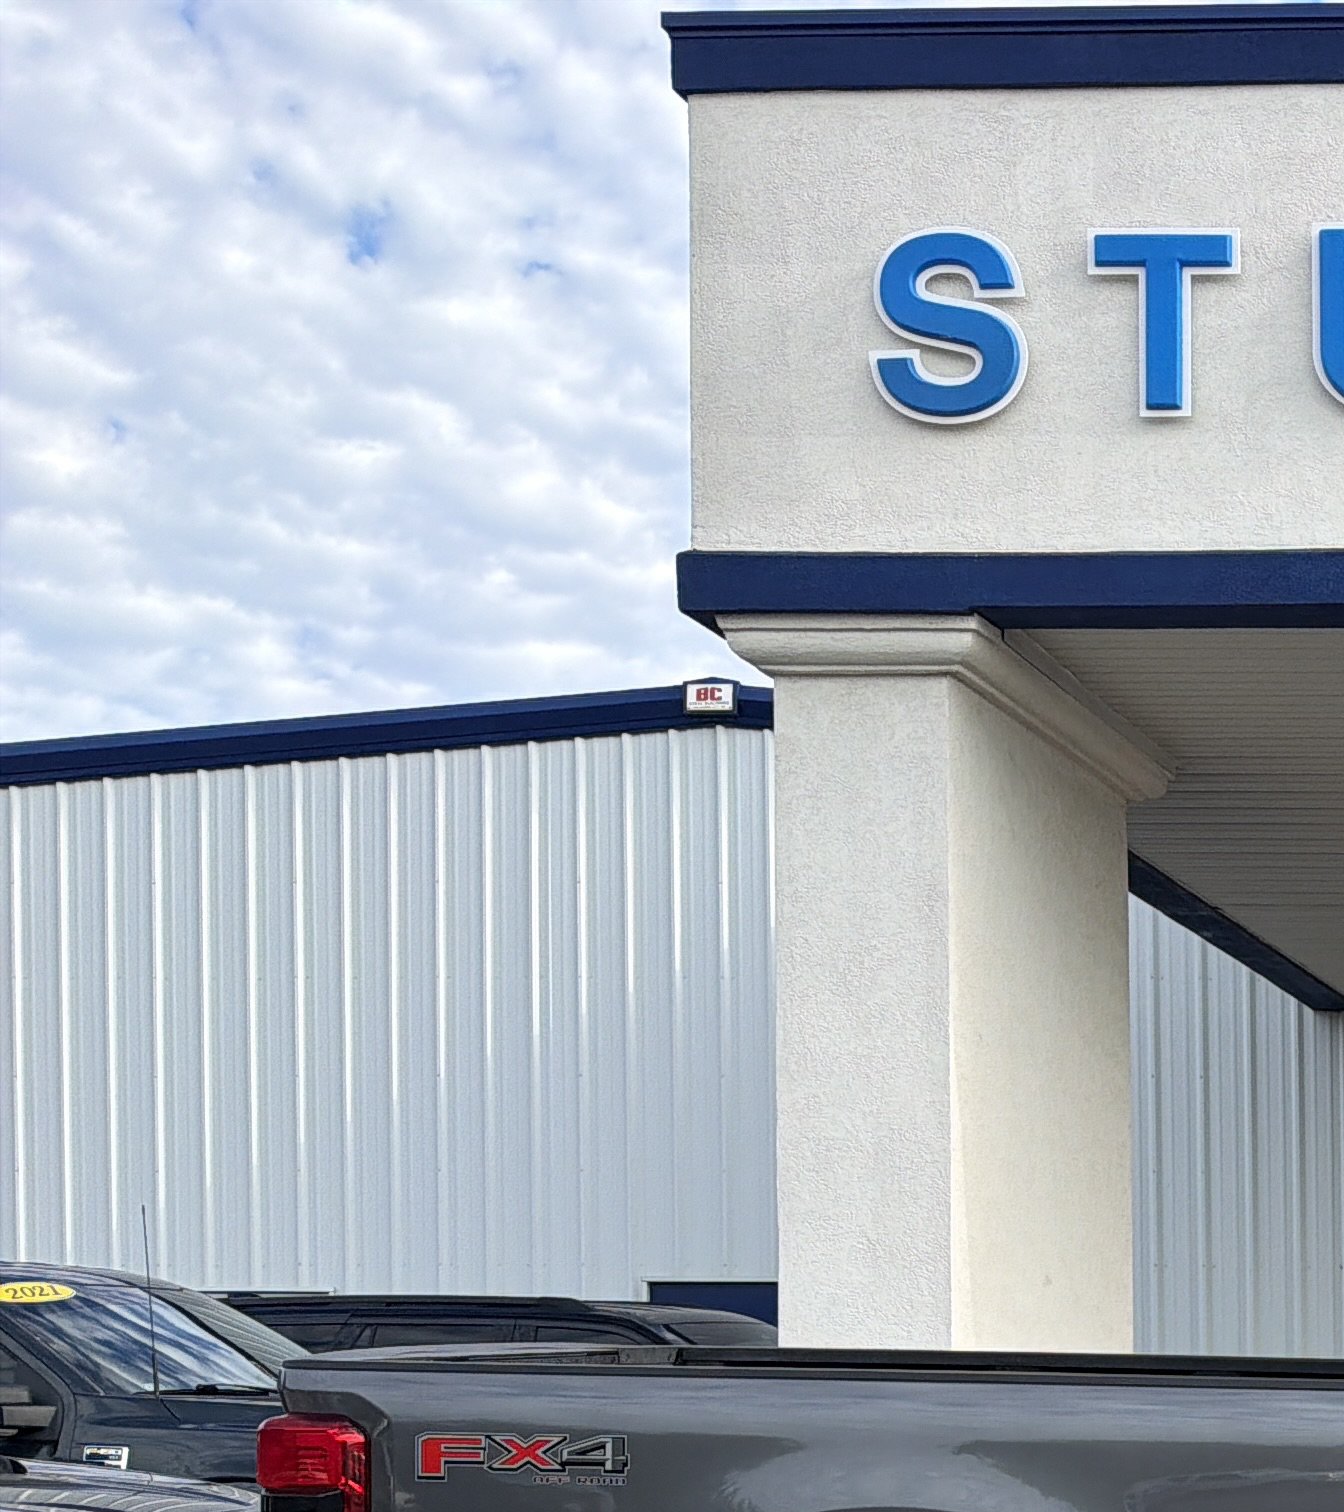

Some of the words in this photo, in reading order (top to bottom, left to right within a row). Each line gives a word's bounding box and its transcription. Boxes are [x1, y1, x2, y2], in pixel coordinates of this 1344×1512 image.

[5, 1286, 62, 1299] 2021
[415, 1432, 629, 1481] FX4
[532, 1476, 570, 1486] OFF
[576, 1476, 628, 1486] ROAD
